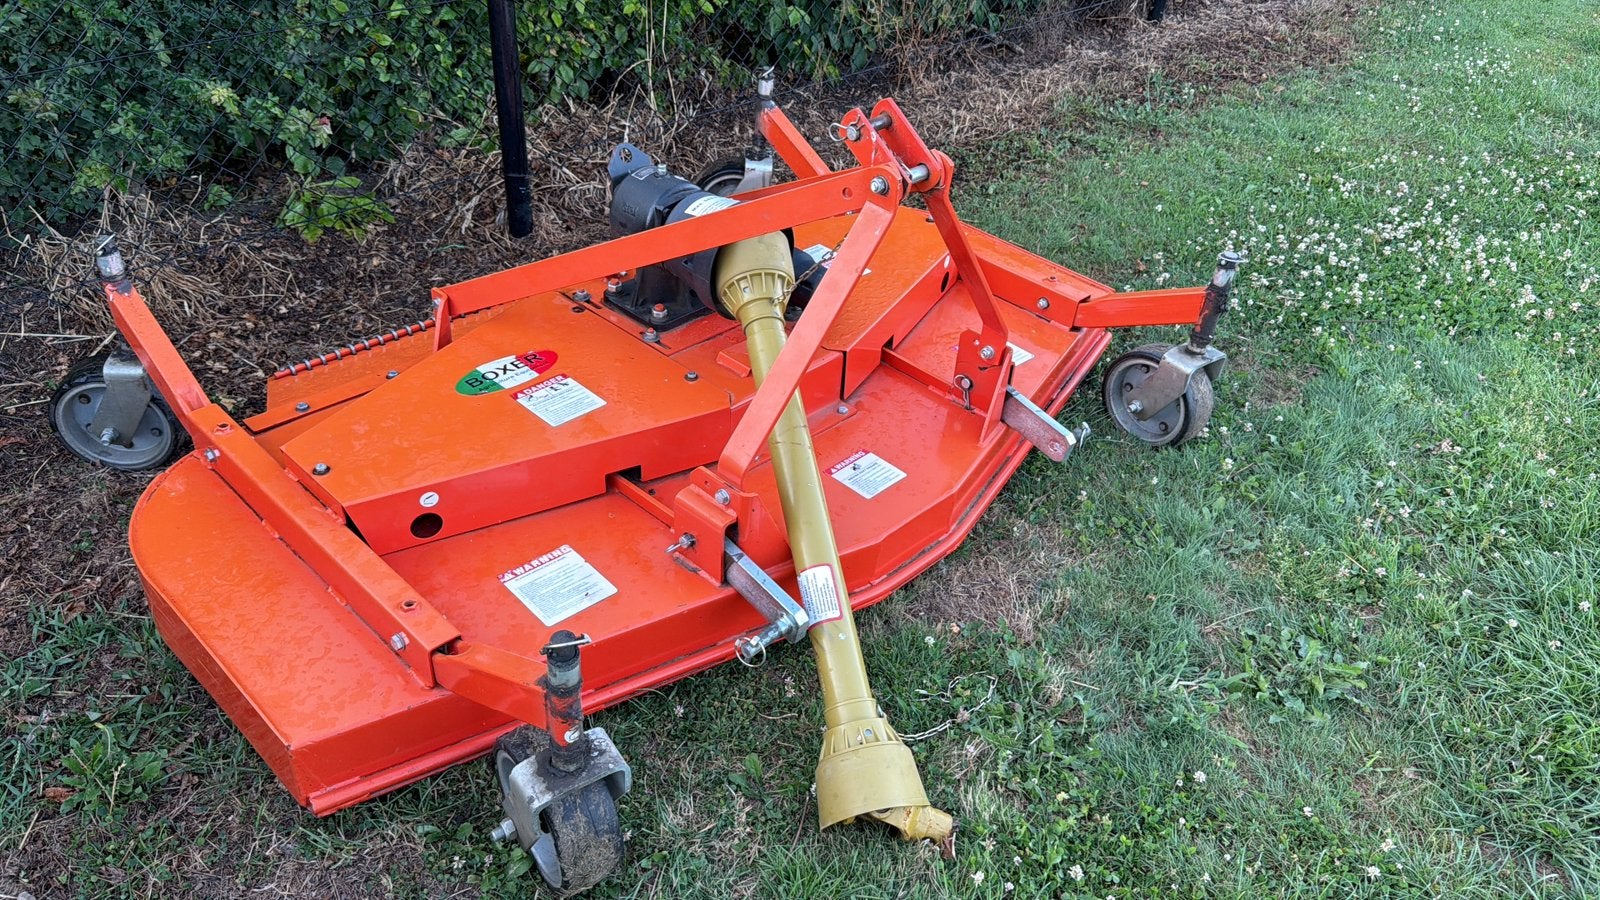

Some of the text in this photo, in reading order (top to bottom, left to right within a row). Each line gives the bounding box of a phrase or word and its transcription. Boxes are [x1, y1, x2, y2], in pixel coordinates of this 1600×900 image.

[465, 352, 543, 388] BOXER
[525, 374, 567, 395] DANGER
[834, 451, 866, 469] WARNING
[513, 545, 571, 575] WARNING
